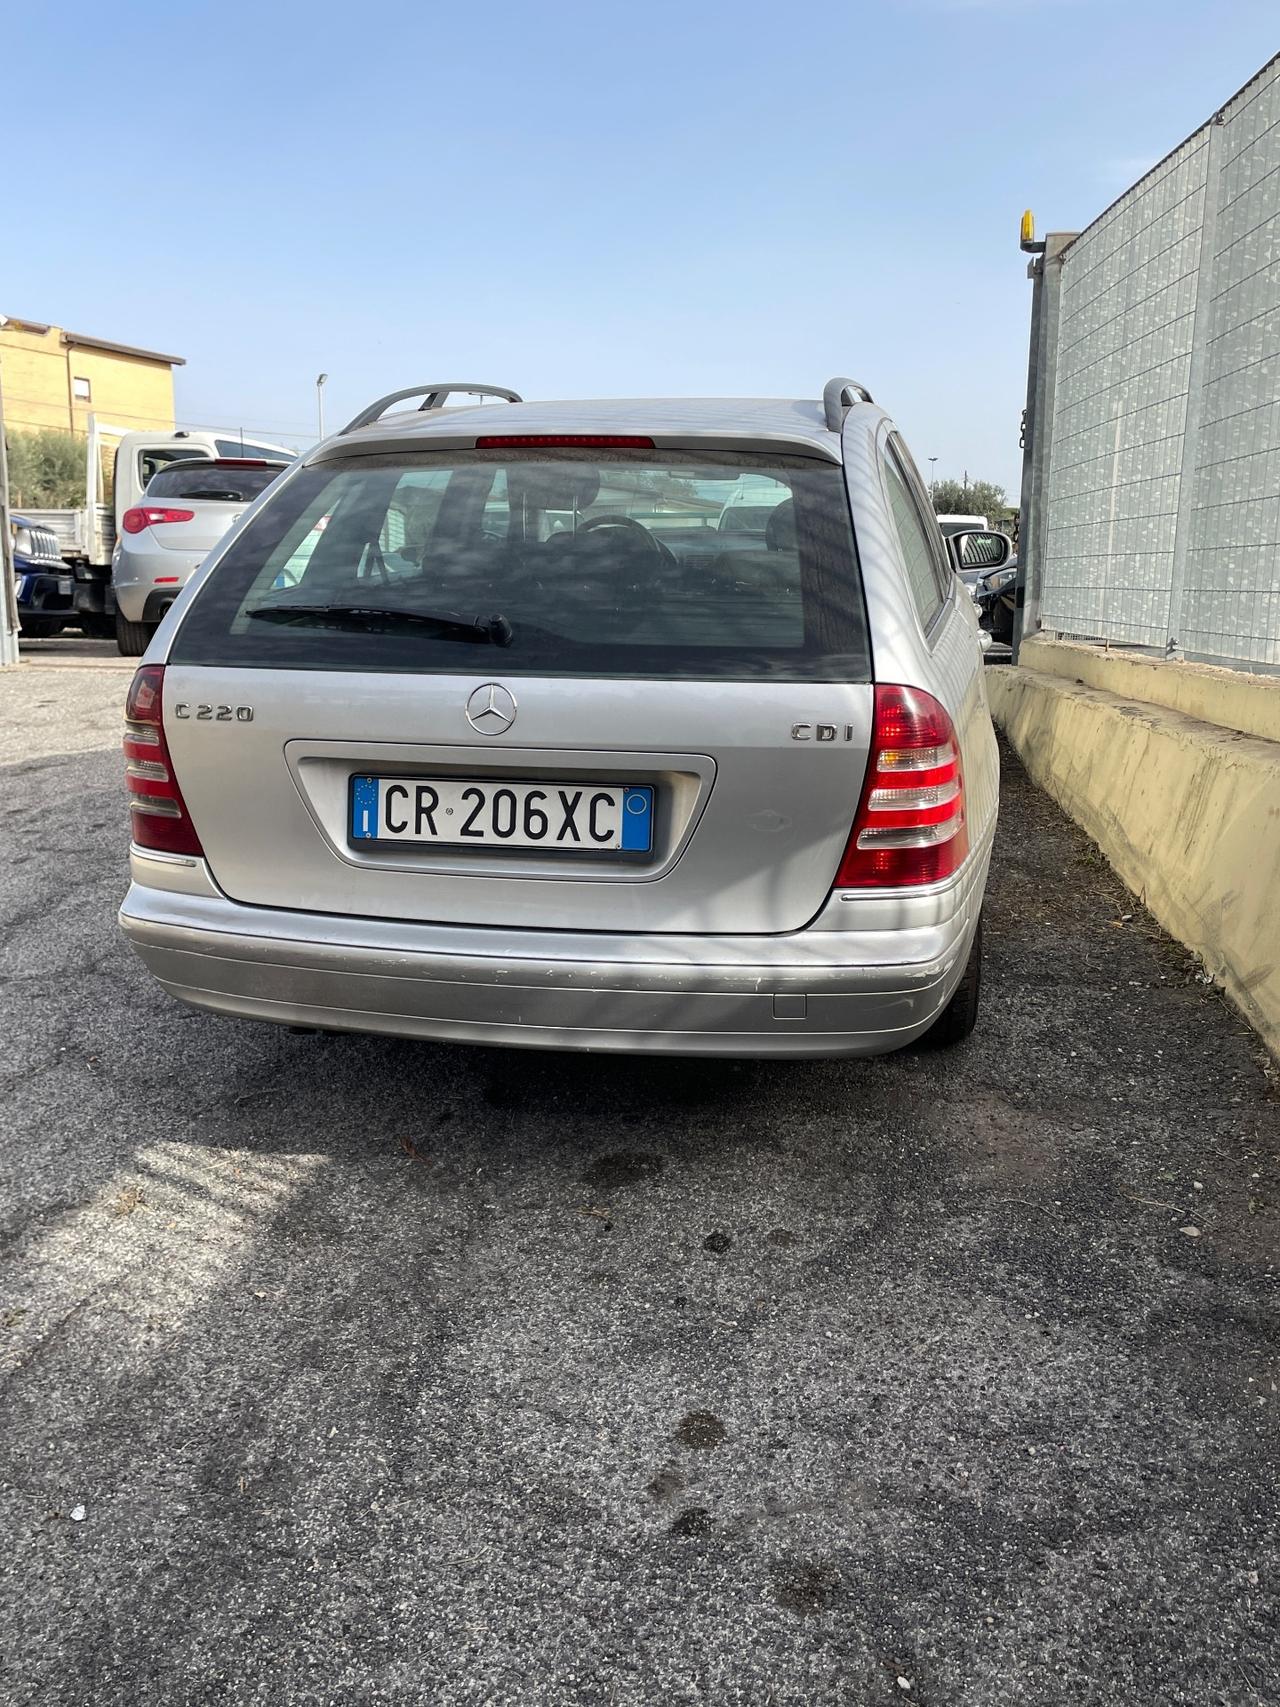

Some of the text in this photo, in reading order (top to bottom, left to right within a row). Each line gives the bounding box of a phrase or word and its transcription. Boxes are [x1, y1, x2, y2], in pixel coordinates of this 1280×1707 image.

[791, 722, 853, 741] CDI
[362, 810, 369, 832] I
[385, 784, 616, 842] CR 206XC
